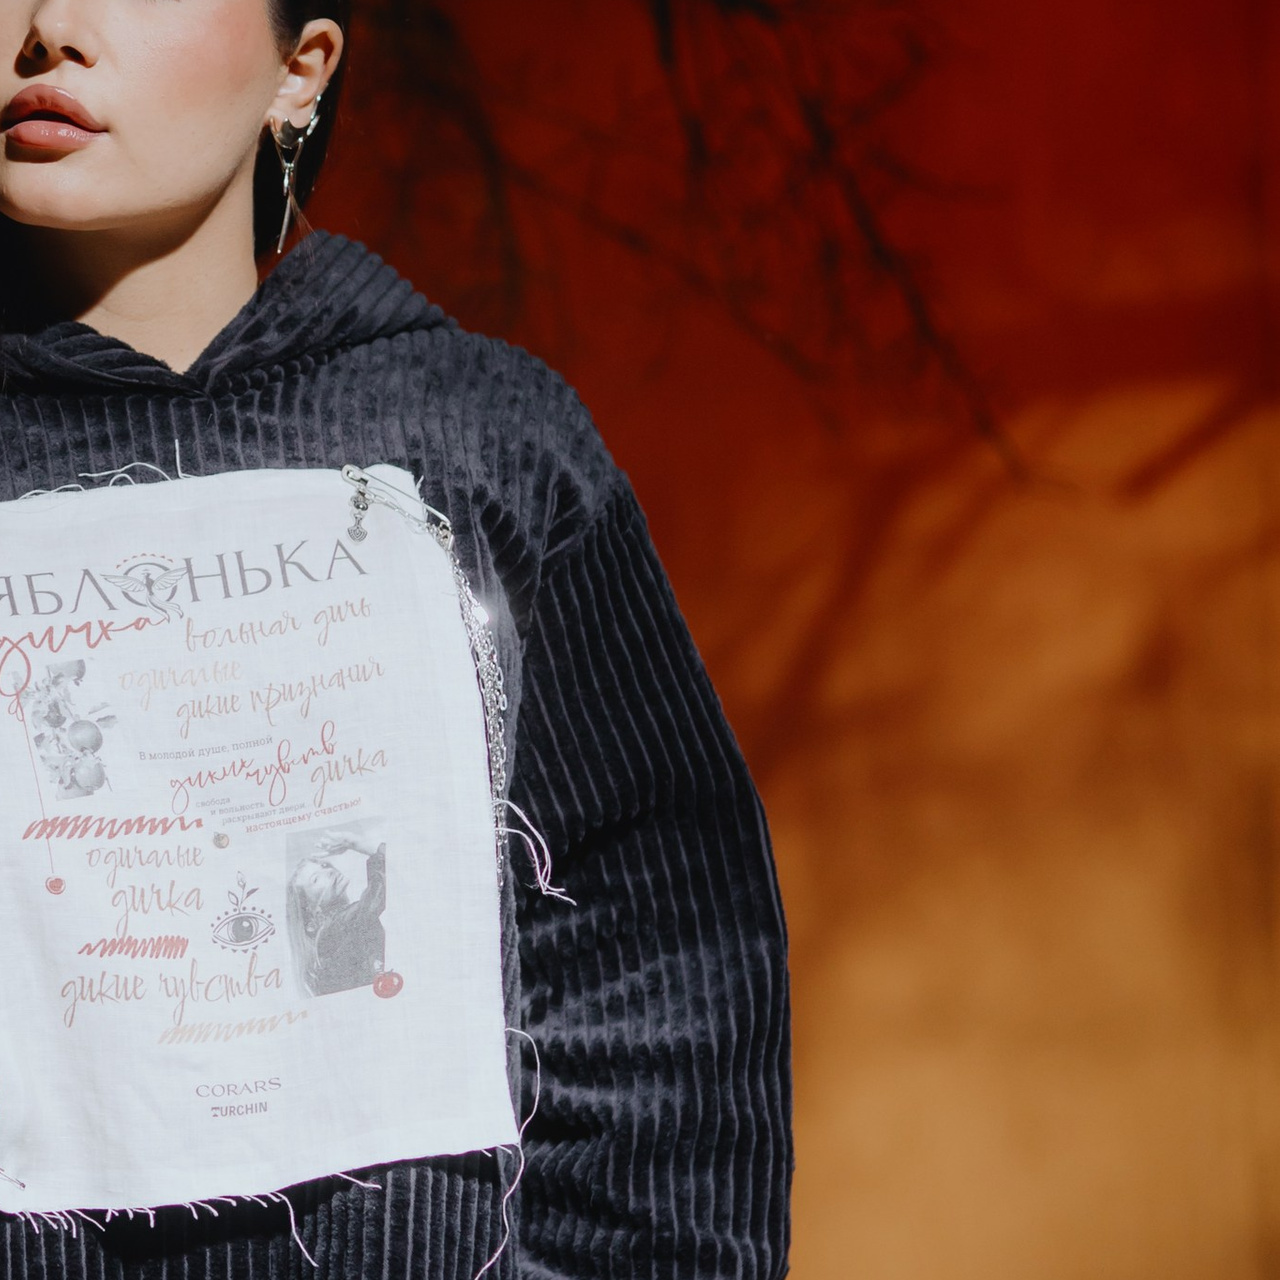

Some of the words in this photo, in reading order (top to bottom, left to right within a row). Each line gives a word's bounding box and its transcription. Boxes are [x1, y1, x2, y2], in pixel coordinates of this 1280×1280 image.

[186, 610, 301, 651] вольная
[314, 598, 371, 646] дичь
[176, 694, 241, 740] дикие
[250, 656, 384, 726] признания
[138, 751, 147, 761] В
[149, 748, 195, 761] молодой
[198, 744, 230, 758] душе,
[232, 735, 273, 751] полной
[170, 758, 254, 815] диких
[245, 720, 337, 807] чувств
[311, 747, 388, 807] дичка
[195, 796, 231, 809] свобода
[219, 801, 266, 815] вольность
[222, 808, 277, 825] раскрывают
[246, 812, 312, 833] настоящему
[315, 797, 362, 818] счастью!
[86, 845, 204, 889] одичалые
[111, 880, 204, 938] дичка
[61, 971, 147, 1028] дикие
[159, 952, 282, 1026] чувства
[195, 1077, 282, 1098] CORARS
[211, 1102, 268, 1118] TURCHIN
